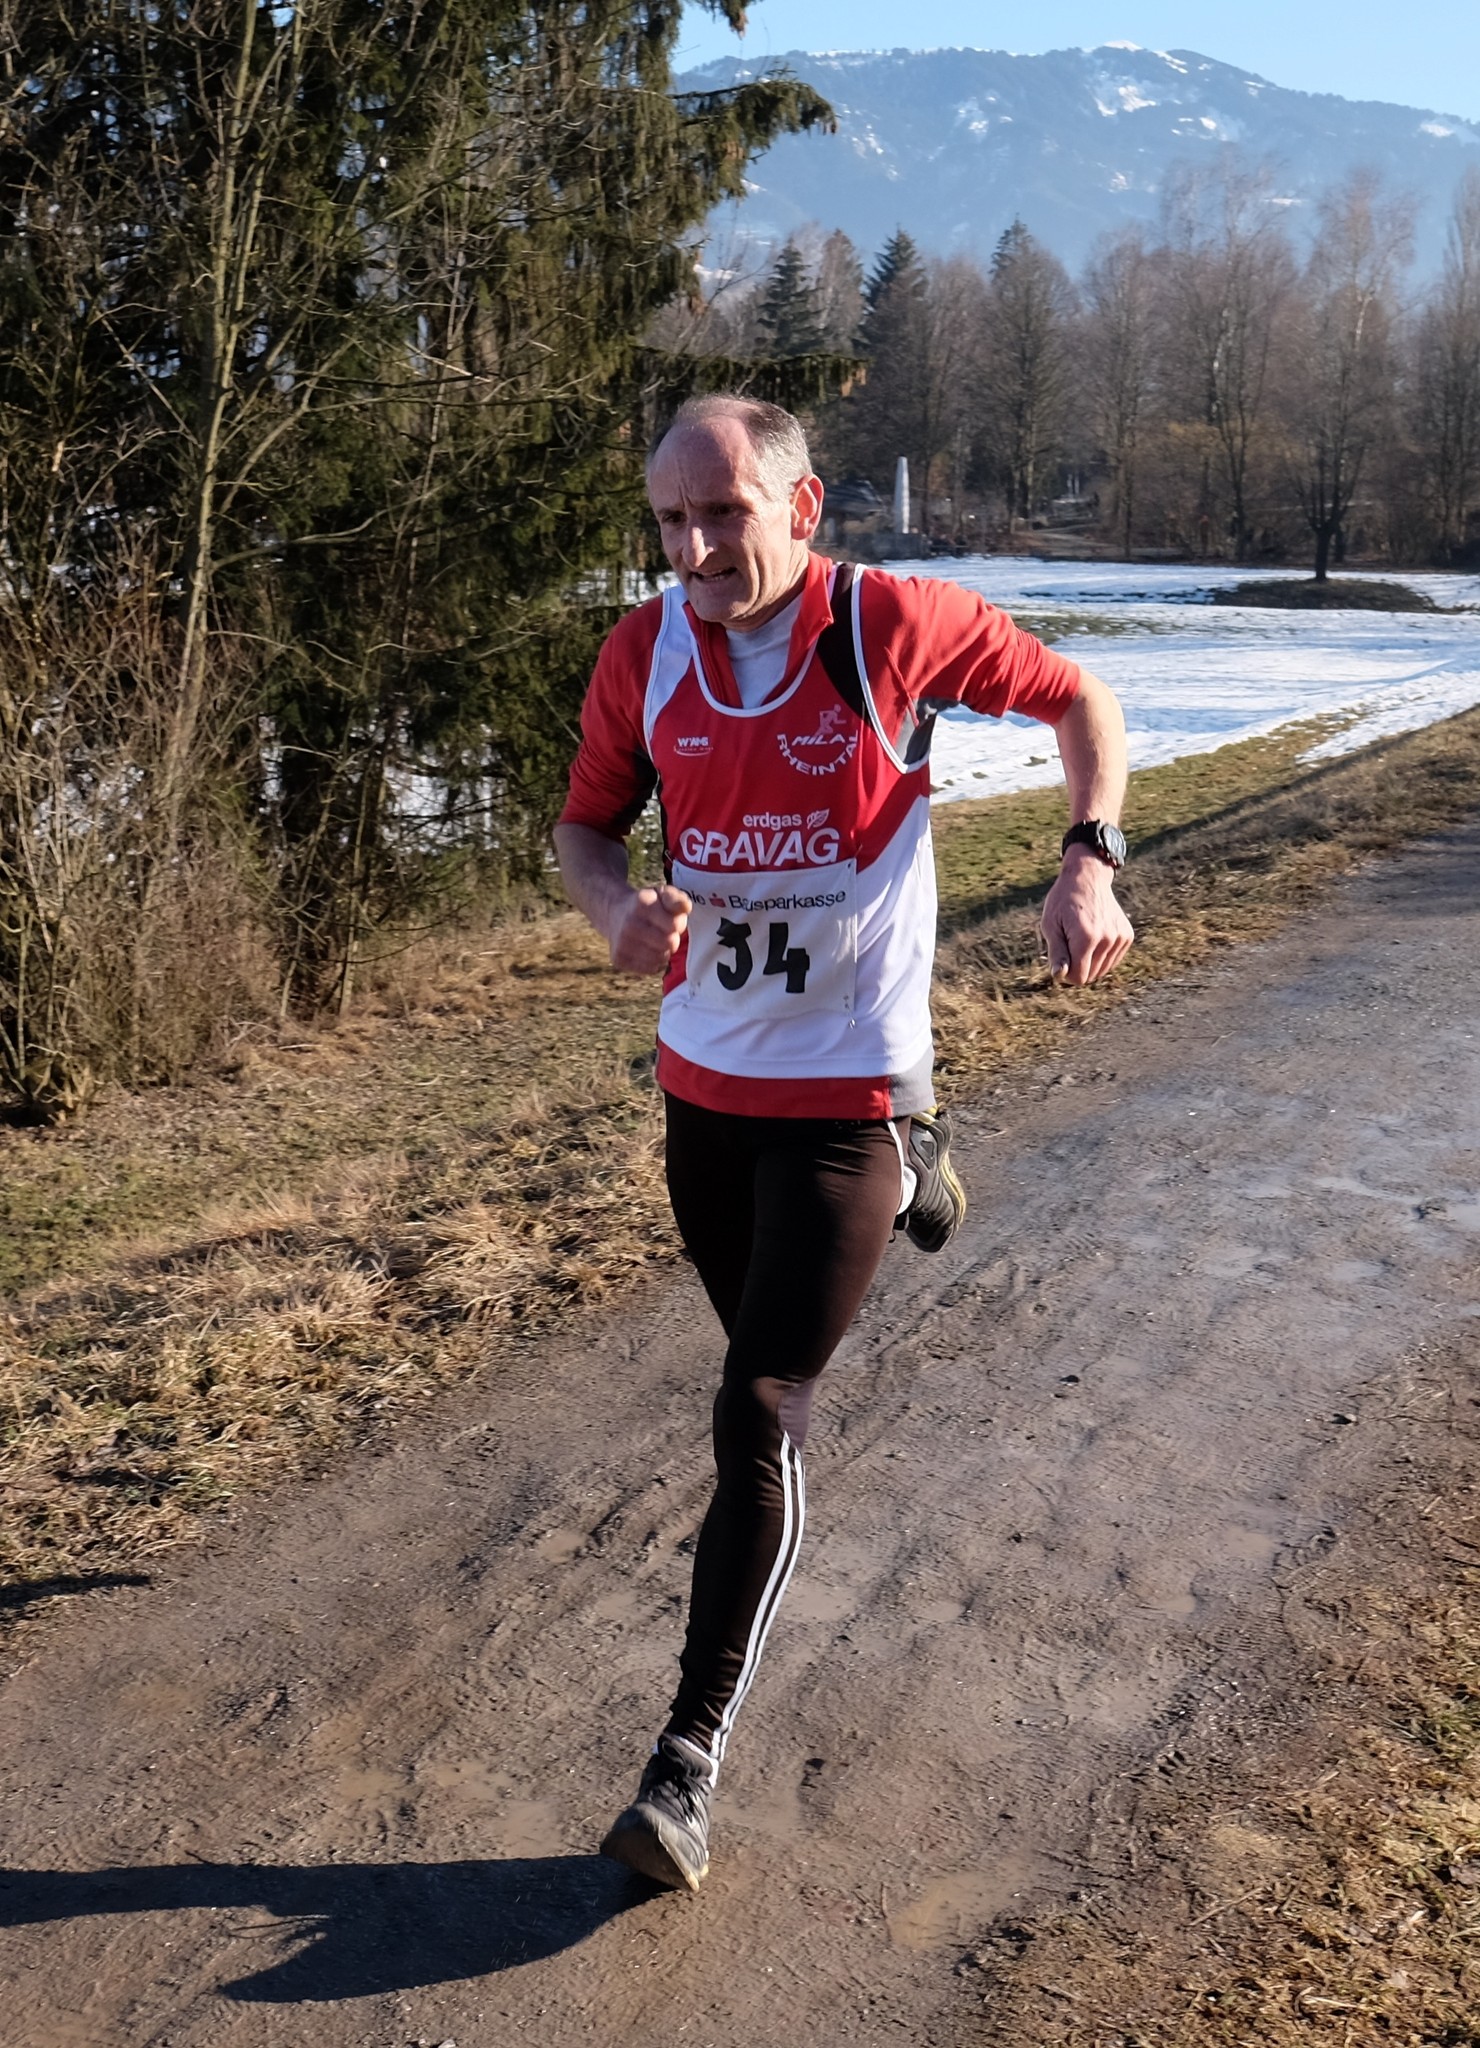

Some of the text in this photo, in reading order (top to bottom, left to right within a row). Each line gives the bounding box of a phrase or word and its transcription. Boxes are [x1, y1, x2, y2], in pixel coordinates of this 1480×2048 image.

[777, 729, 859, 776] RHEINTAL
[792, 733, 846, 746] MILA
[743, 812, 802, 831] erdgas
[680, 827, 840, 866] GRAVAG
[716, 917, 810, 994] 34
